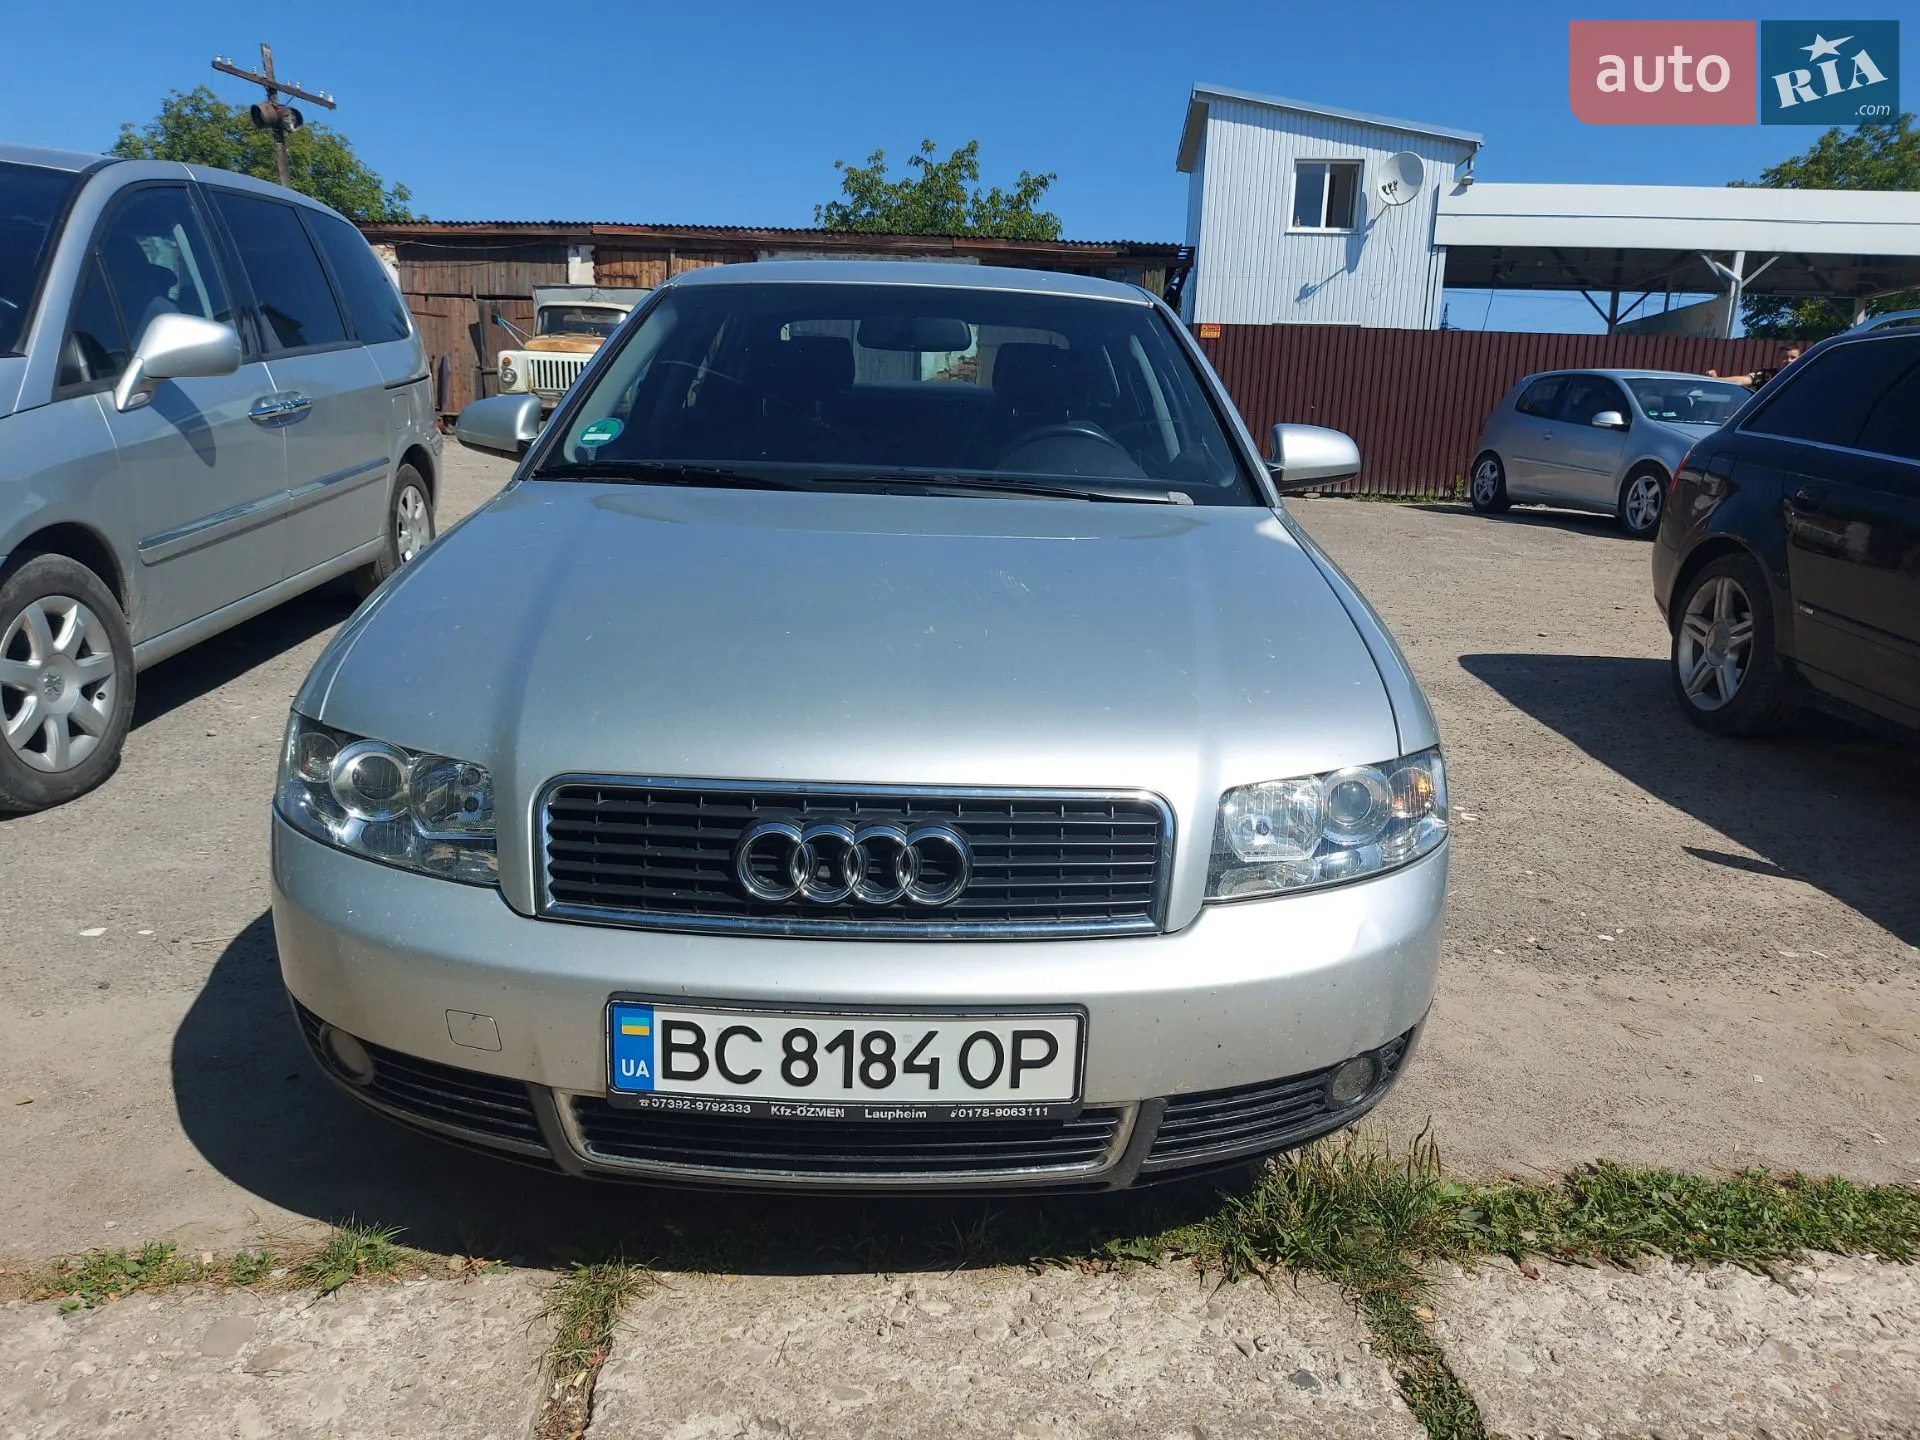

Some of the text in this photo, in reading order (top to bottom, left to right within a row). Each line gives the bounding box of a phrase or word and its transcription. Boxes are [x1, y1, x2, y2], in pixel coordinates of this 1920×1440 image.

[662, 1019, 1059, 1090] BC 8184 OP
[621, 1058, 650, 1079] UA
[864, 1108, 927, 1120] Laupheim
